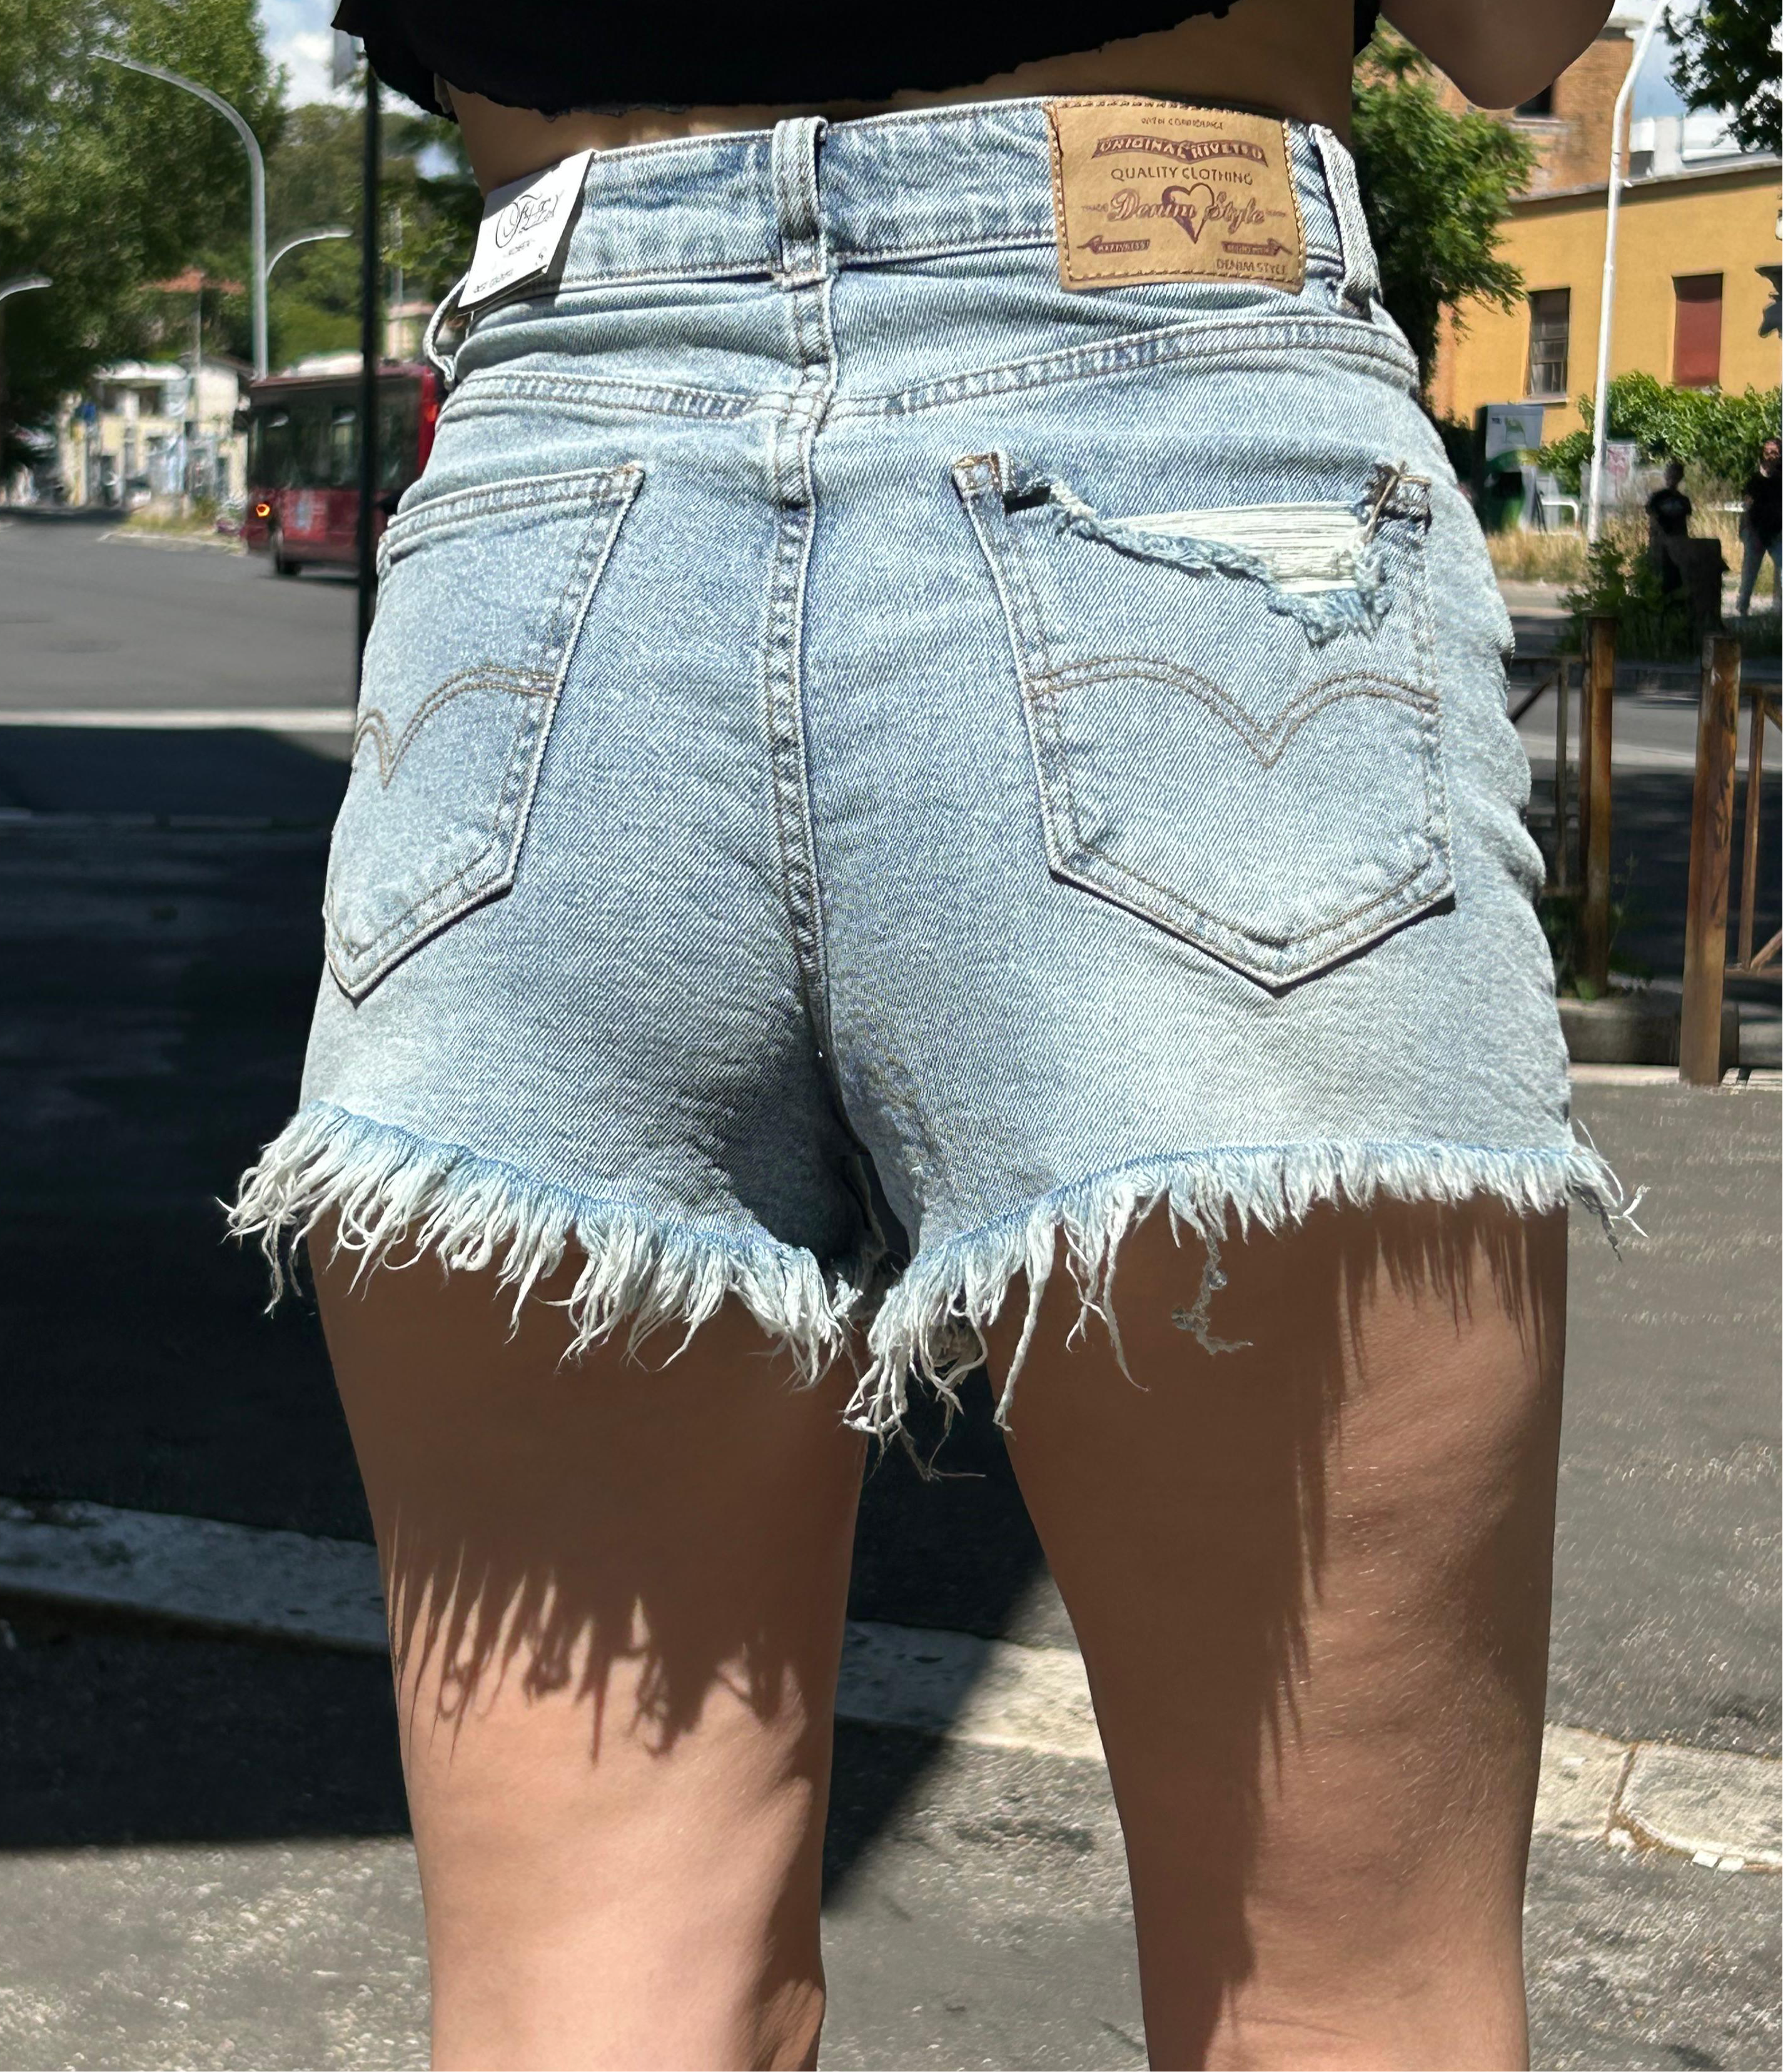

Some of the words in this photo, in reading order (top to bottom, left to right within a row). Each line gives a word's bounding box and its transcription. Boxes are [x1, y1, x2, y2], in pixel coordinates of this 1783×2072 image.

[1111, 166, 1178, 181] QUALITY
[1181, 166, 1253, 185] CLOTHING
[1106, 188, 1198, 222] Denim
[1205, 191, 1265, 235] Style
